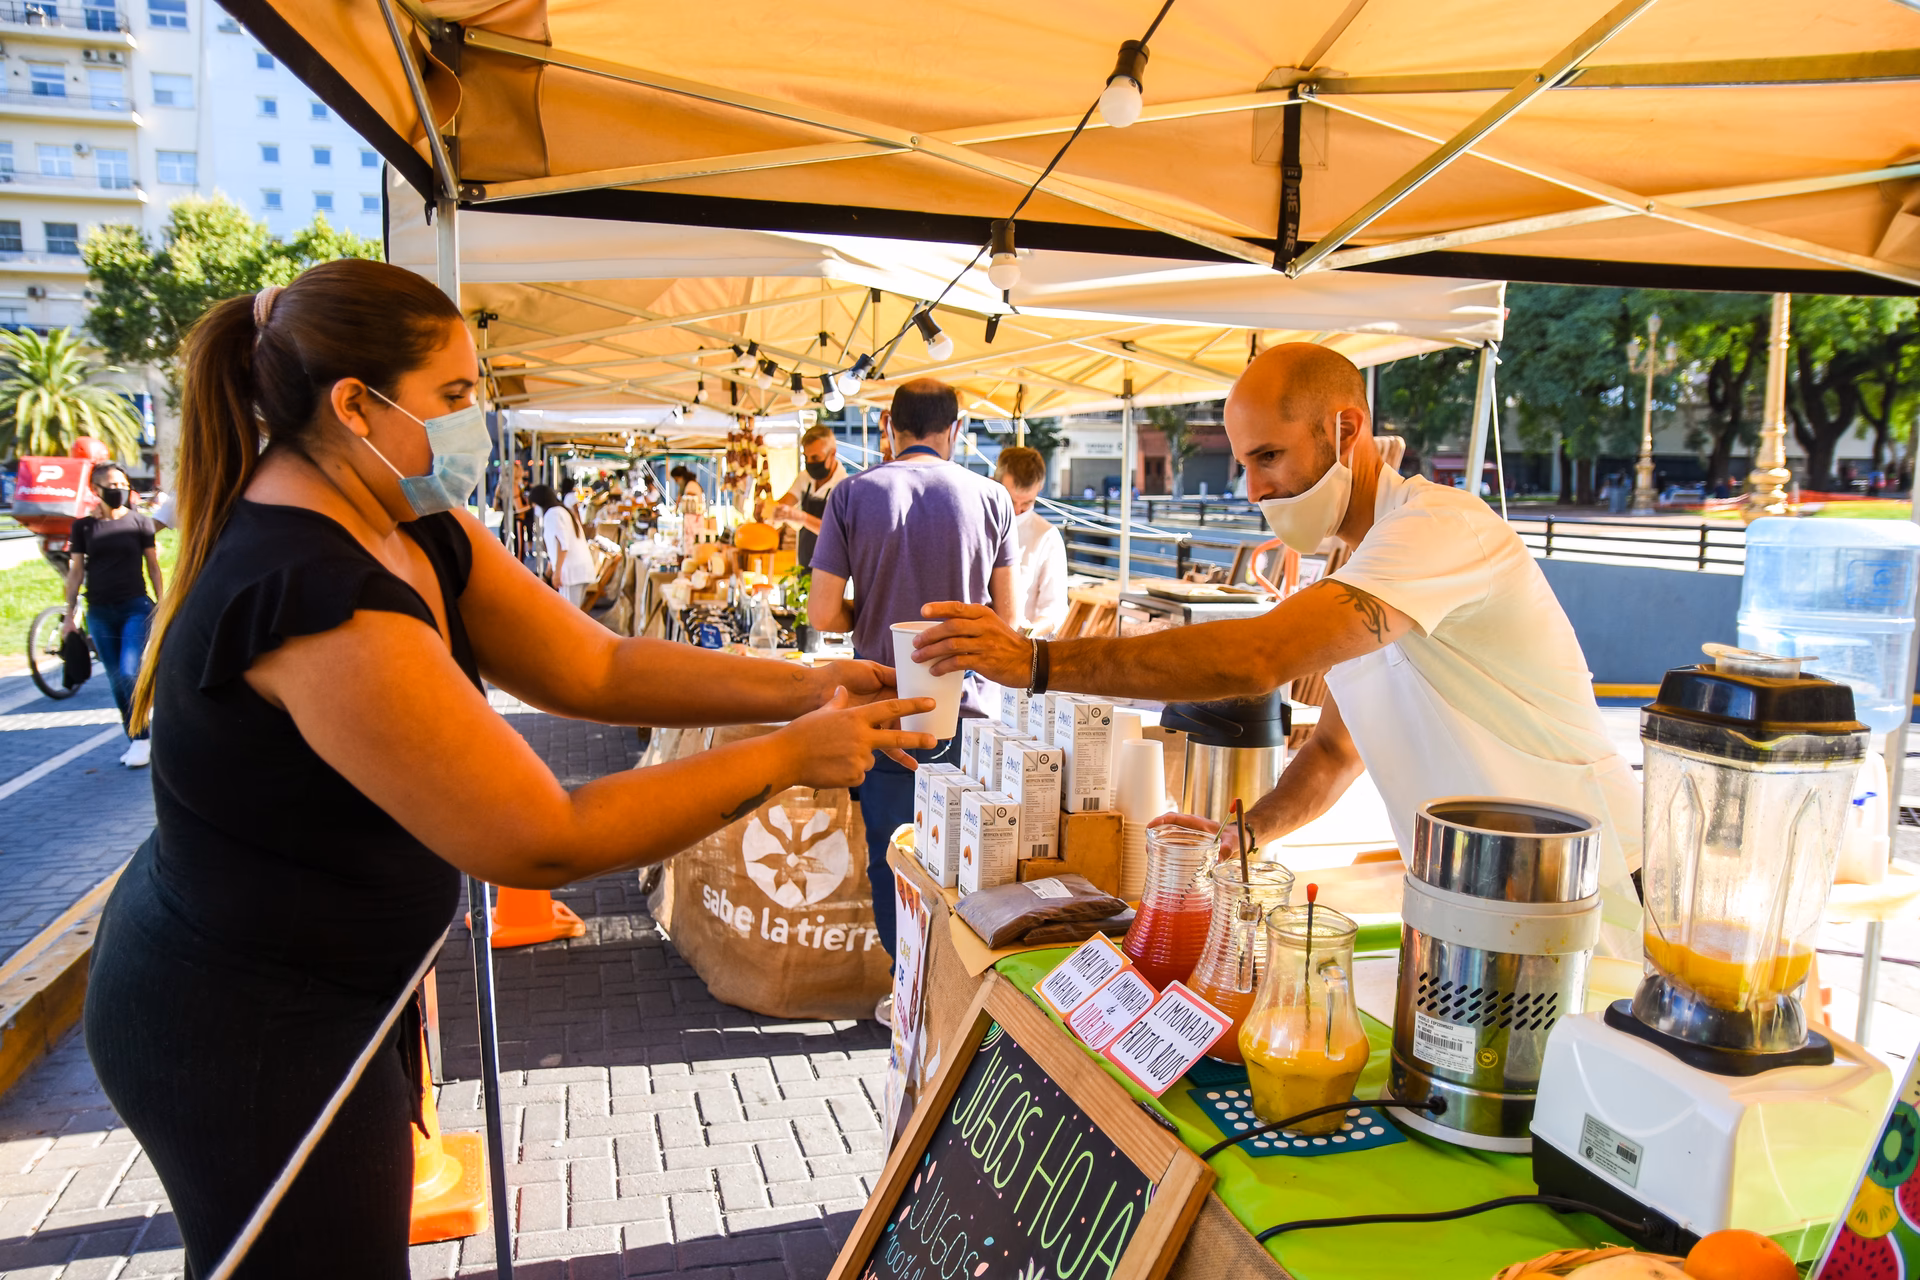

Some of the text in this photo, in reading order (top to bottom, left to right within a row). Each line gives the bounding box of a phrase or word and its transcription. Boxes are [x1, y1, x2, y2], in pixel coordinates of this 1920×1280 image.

[702, 884, 754, 932] sabe
[760, 907, 789, 945] la
[1069, 944, 1119, 988] MARACUYÁ
[1044, 970, 1082, 1010] NARANJA
[1105, 1003, 1119, 1016] de
[1107, 973, 1150, 1017] LIMONADA
[1072, 1002, 1115, 1048] DURAZNO
[1153, 994, 1215, 1049] LIMONADA
[1116, 1020, 1190, 1085] FRUTOS ROJOS
[952, 1046, 1134, 1280] JUGOS HOJA
[910, 1176, 979, 1280] JUGOS
[885, 1234, 917, 1280] 100%
